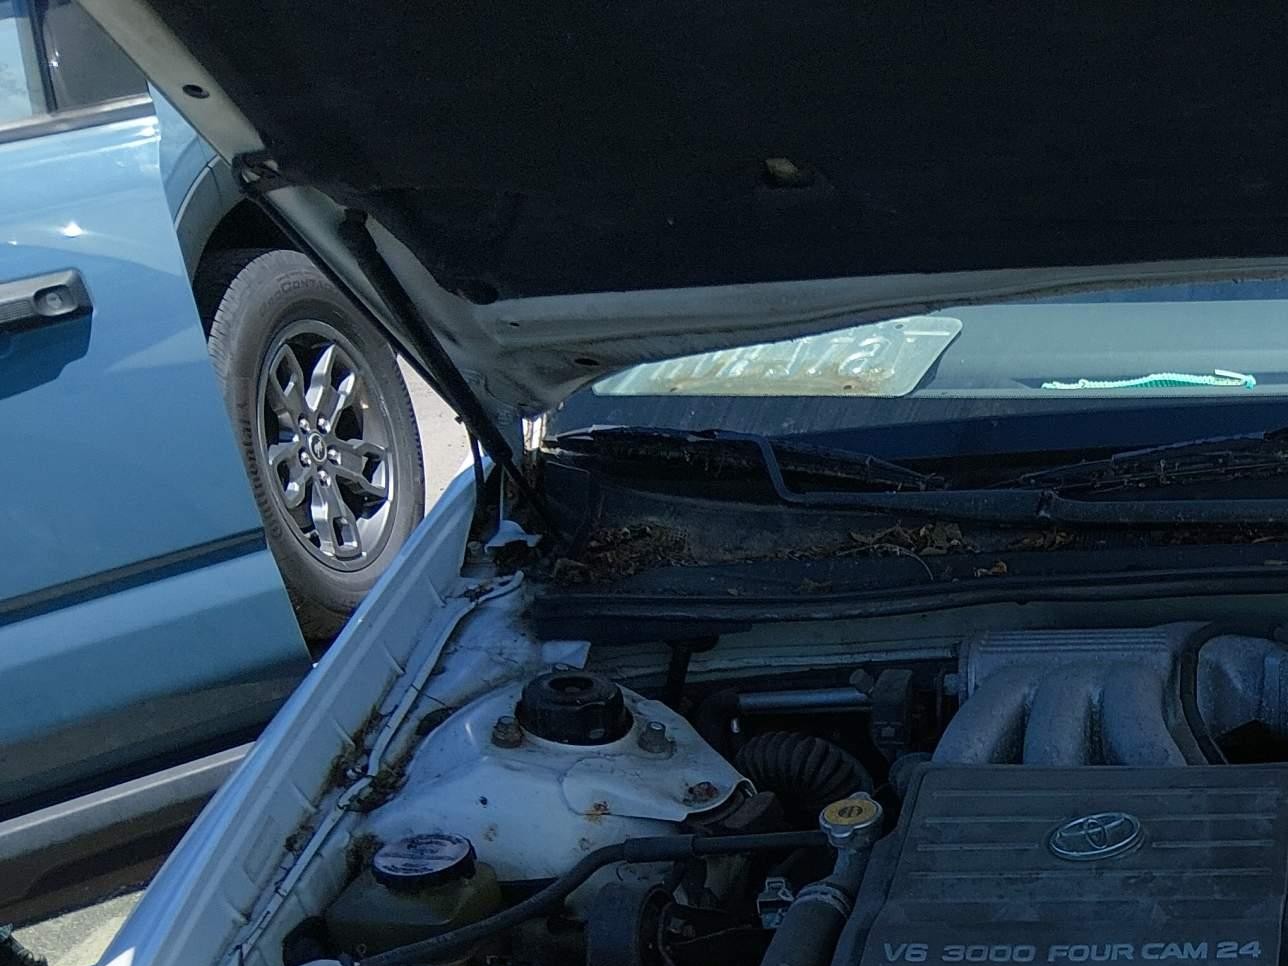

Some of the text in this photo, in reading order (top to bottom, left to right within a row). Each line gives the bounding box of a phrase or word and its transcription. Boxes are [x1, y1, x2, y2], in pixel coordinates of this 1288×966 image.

[884, 941, 1262, 962] V6 3000 FOUR CAM 24
